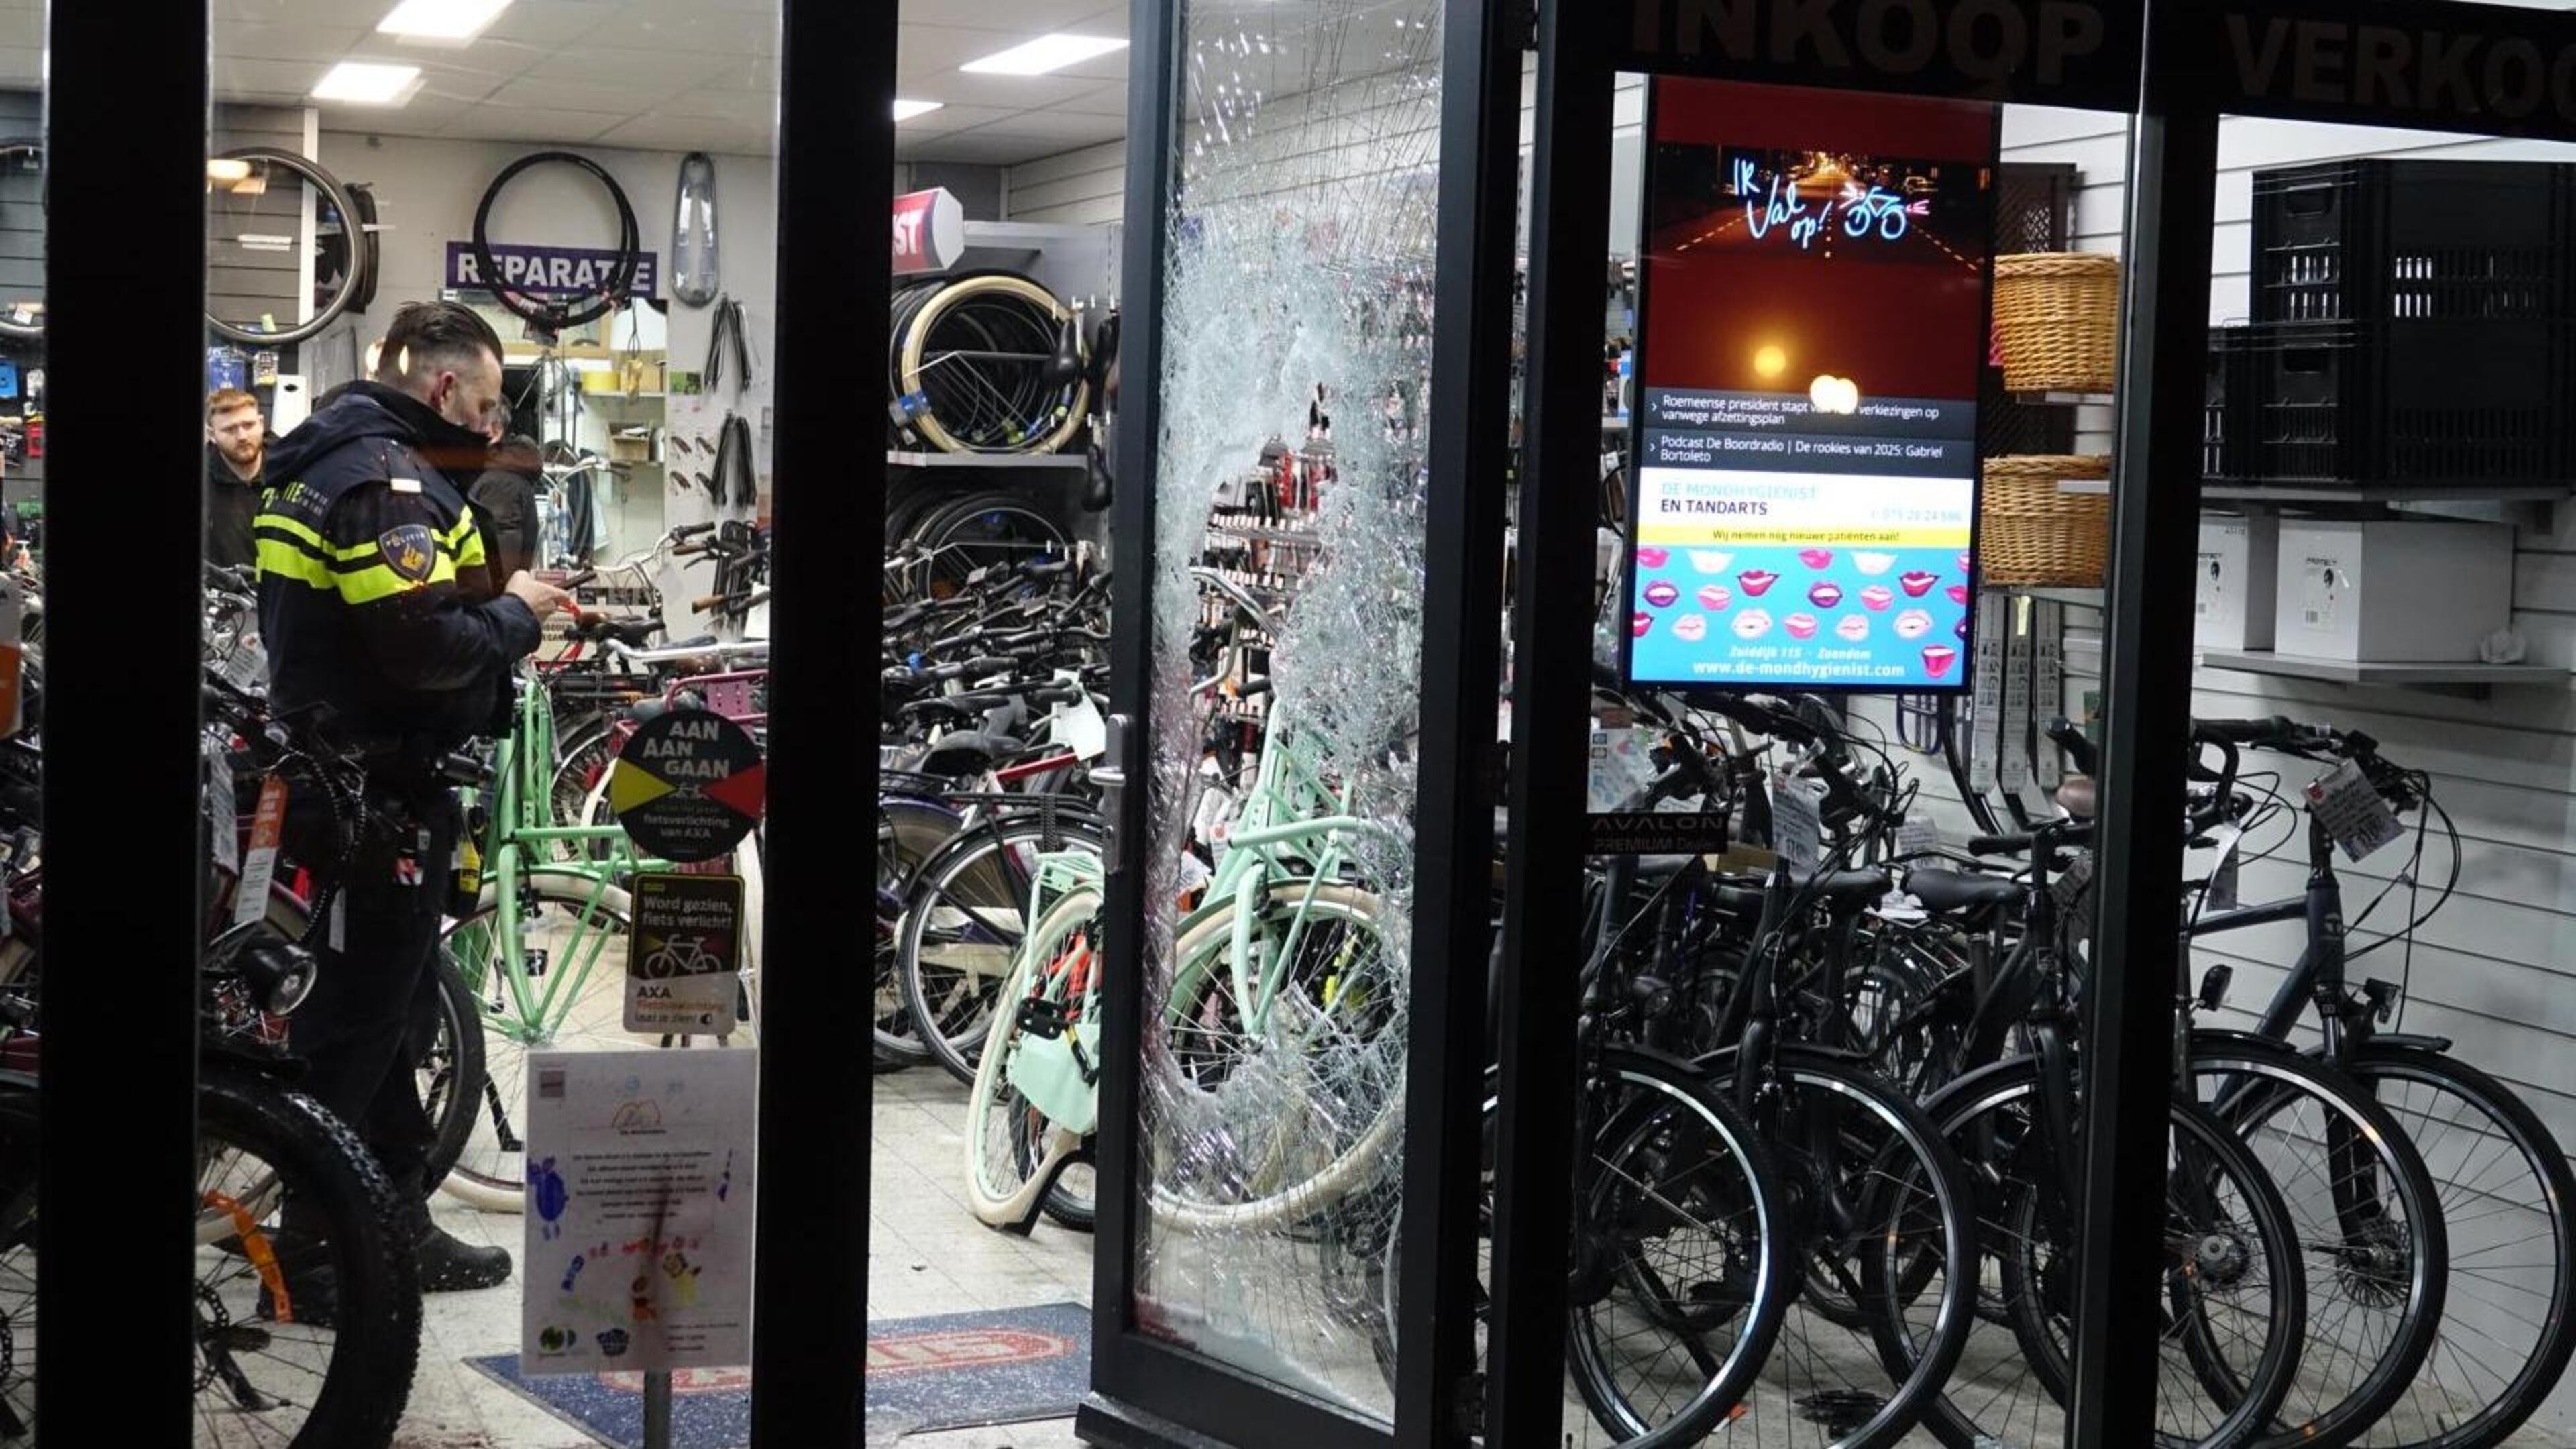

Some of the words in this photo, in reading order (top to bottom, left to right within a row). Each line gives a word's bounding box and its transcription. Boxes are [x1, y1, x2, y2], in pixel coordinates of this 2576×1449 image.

[1633, 0, 2104, 84] INKOOP
[1746, 175, 1806, 240] Val
[892, 206, 922, 255] ST
[1663, 394, 1726, 410] Roemeense
[1727, 398, 1779, 413] president
[1781, 401, 1808, 414] stapt
[1859, 403, 1923, 421] verkiezingen
[1925, 408, 1939, 421] op
[1662, 411, 1710, 425] vanwege
[1711, 411, 1786, 427] afzettingsplan
[1661, 435, 1704, 449] Podcast
[1706, 438, 1722, 449] De
[1723, 438, 1784, 453] Boordradio
[1795, 441, 1811, 453] De
[1813, 442, 1852, 455] rookies
[1853, 445, 1873, 455] van
[1874, 444, 1904, 456] 2025:
[1907, 445, 1943, 458] Gabriel
[1660, 450, 1711, 465] Bortoleto
[1660, 499, 1681, 513] EN
[1684, 500, 1768, 515] TANDARTS
[1713, 530, 1729, 541] Wij
[1769, 533, 1787, 543] nog
[1790, 532, 1824, 540] nieuwe
[1693, 661, 1905, 678] www.de-mondhygienist.com
[669, 720, 720, 741] AAN
[642, 738, 693, 757] AAN
[664, 759, 729, 779] GAAN
[1592, 815, 1723, 832] AVALON
[643, 895, 680, 910] Word
[642, 911, 676, 927] fiets
[637, 985, 672, 998] AXA
